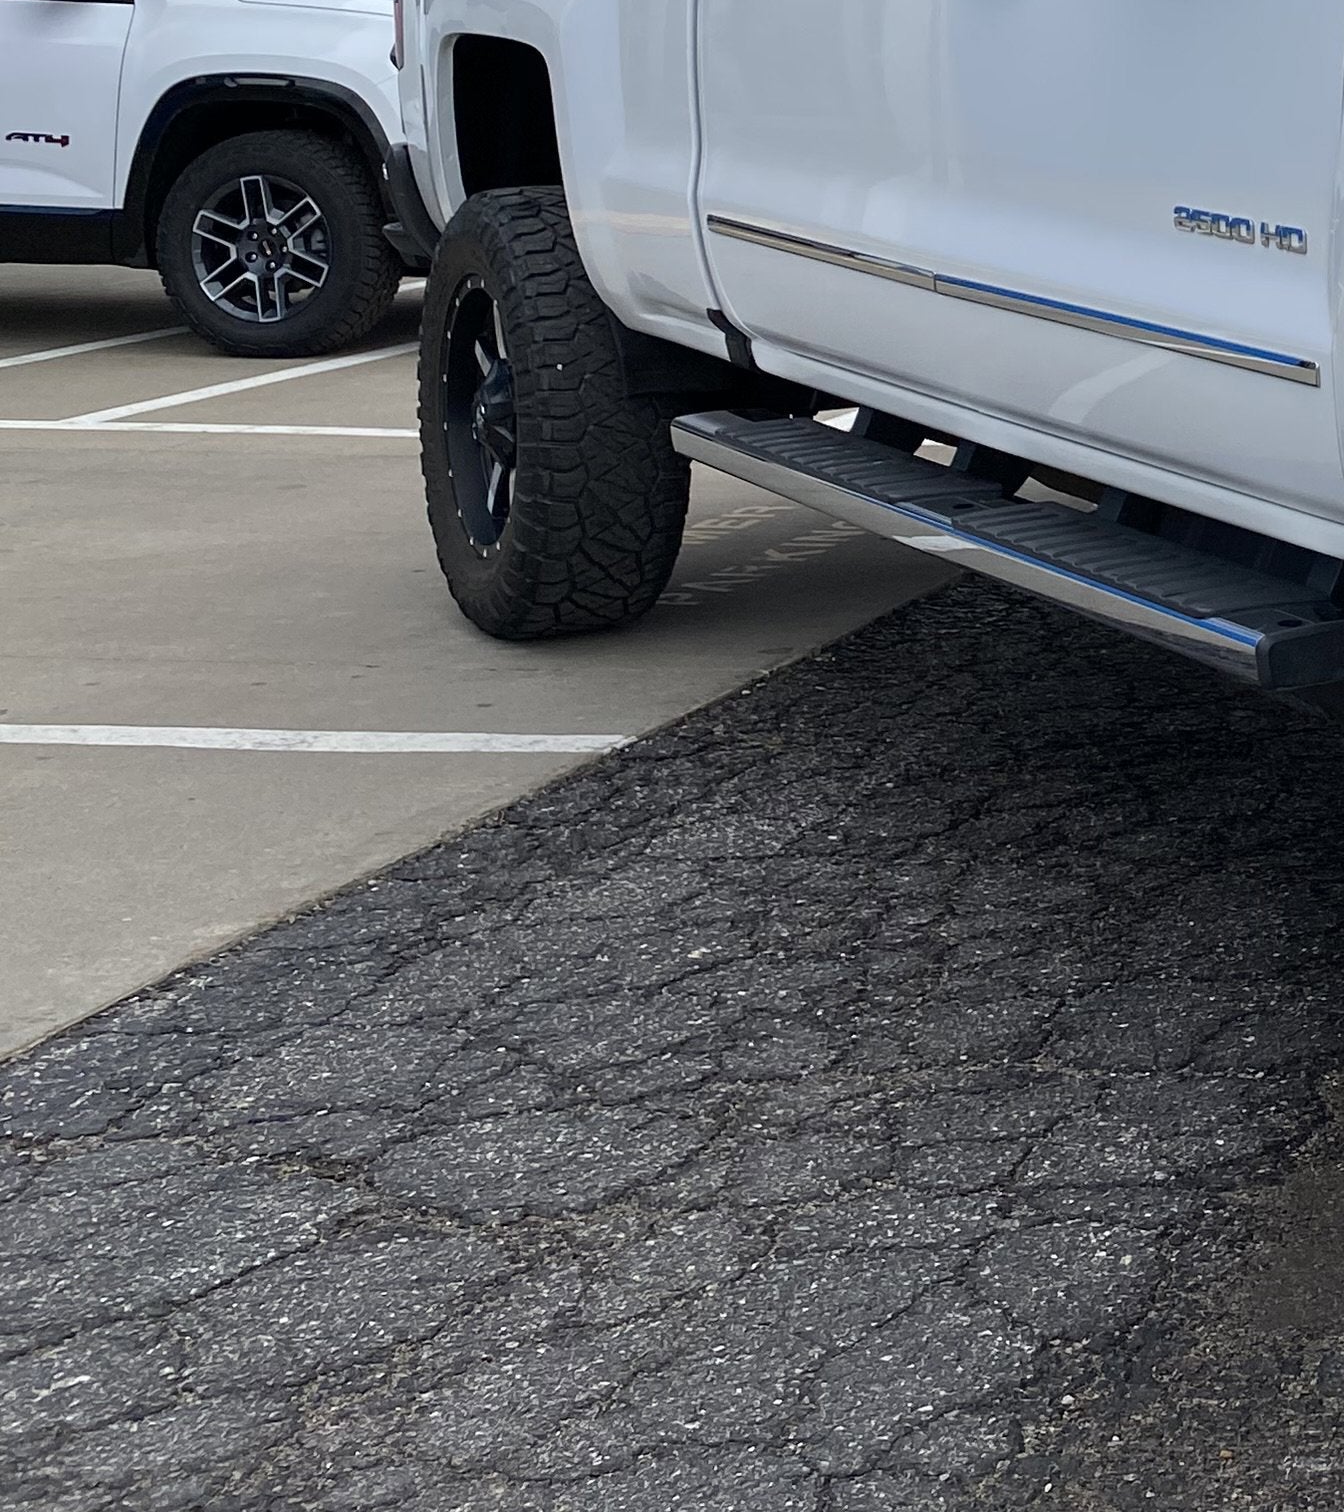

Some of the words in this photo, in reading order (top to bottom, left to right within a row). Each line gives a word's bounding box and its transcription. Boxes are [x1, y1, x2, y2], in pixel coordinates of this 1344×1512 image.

[5, 132, 69, 148] AT4
[1173, 206, 1255, 245] 2500
[1260, 221, 1308, 255] HD
